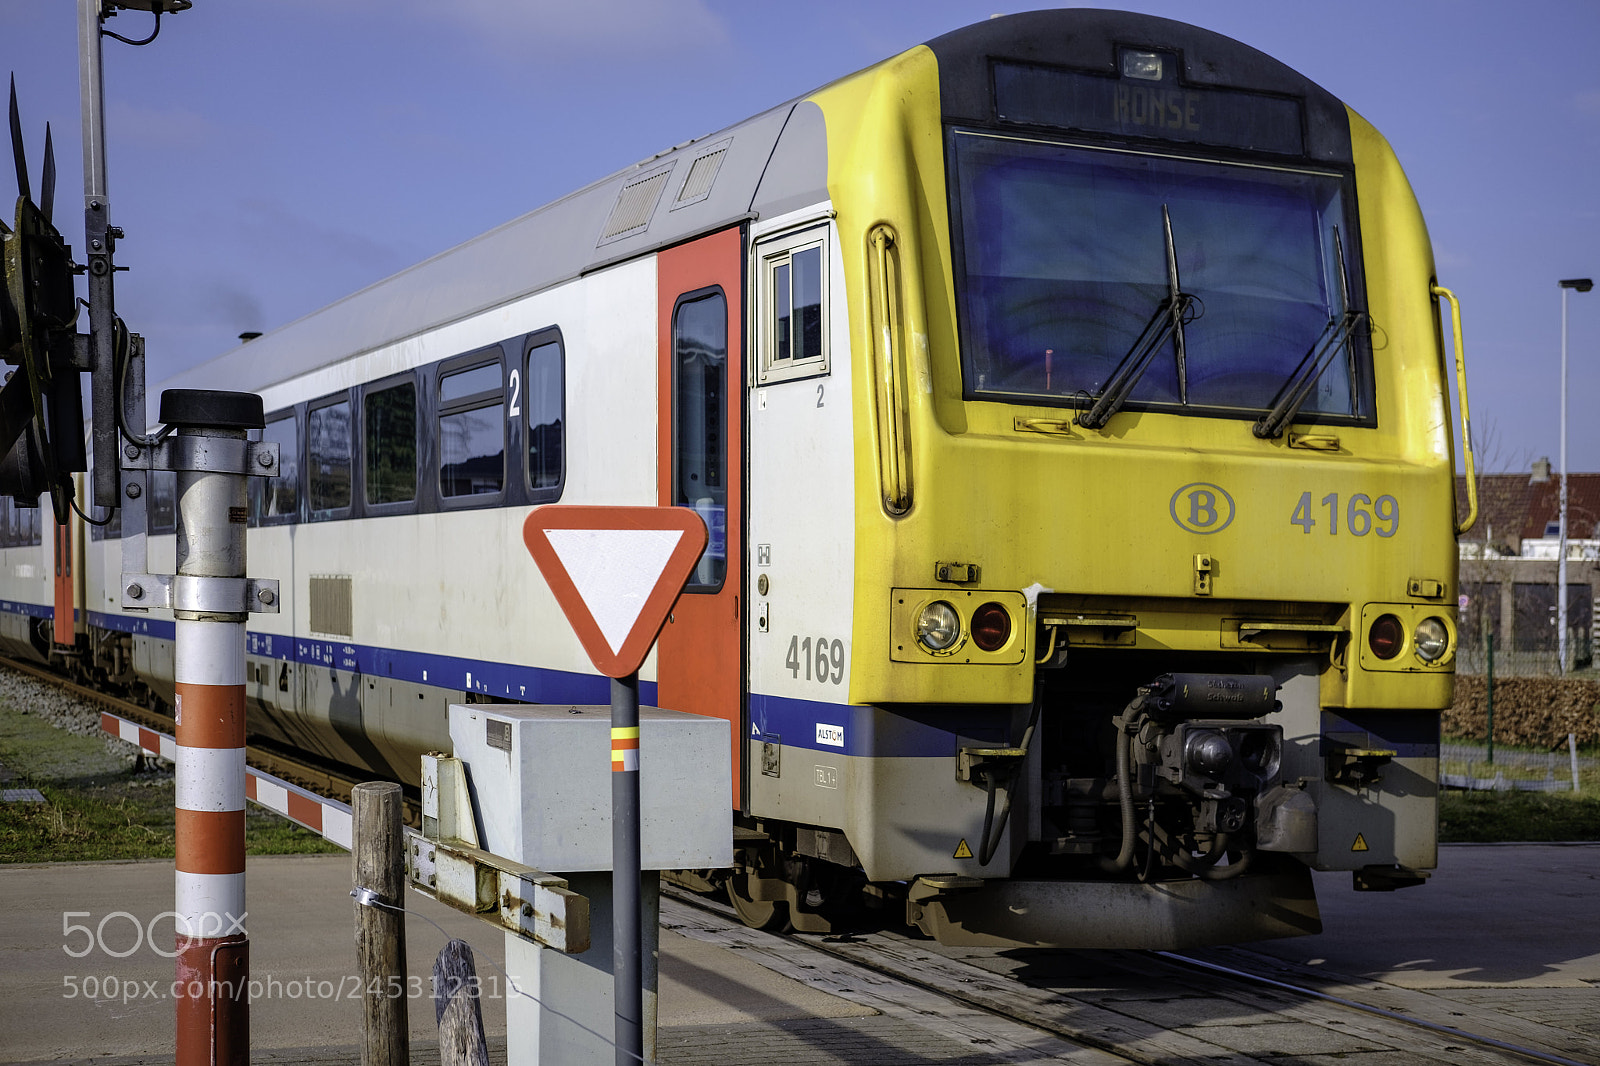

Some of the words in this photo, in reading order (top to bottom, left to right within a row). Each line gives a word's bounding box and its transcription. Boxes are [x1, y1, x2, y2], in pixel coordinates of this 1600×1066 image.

[1113, 83, 1201, 131] RONSE
[509, 368, 520, 417] 2
[816, 383, 825, 409] 2
[1186, 489, 1219, 528] B
[1290, 491, 1400, 538] 4169
[785, 634, 846, 686] 4169
[817, 728, 843, 741] ALSTOM
